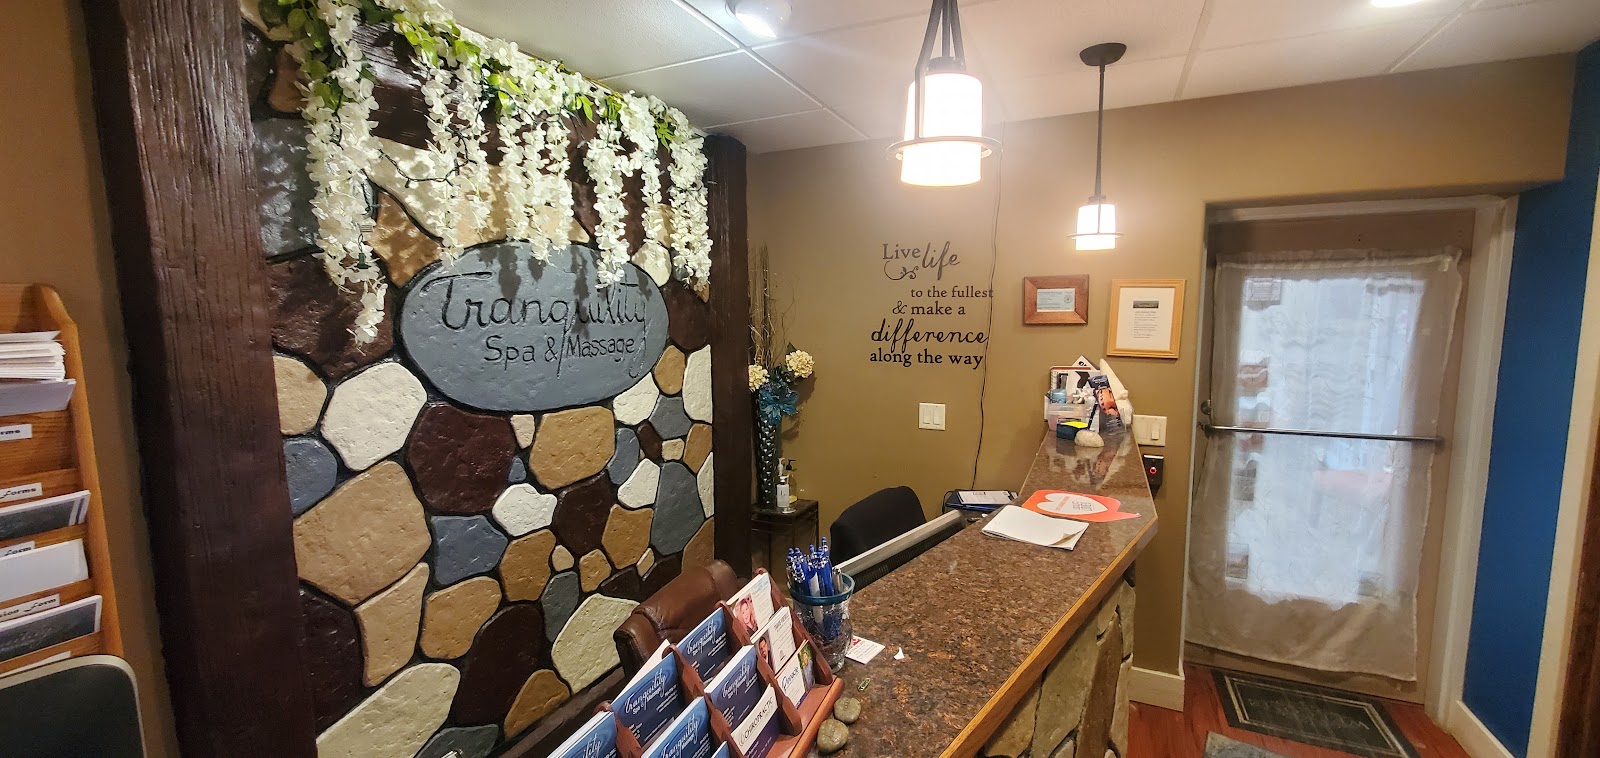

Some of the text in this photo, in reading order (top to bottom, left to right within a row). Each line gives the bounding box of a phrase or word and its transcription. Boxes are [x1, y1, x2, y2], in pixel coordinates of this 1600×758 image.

[882, 241, 961, 281] Live life
[892, 300, 966, 315] & make a
[911, 285, 994, 298] to the fullest
[420, 270, 651, 379] Tranquility
[871, 318, 989, 354] difference
[484, 334, 635, 371] Spa & Massage
[869, 347, 984, 370] along the way
[624, 667, 666, 713] Tranquility
